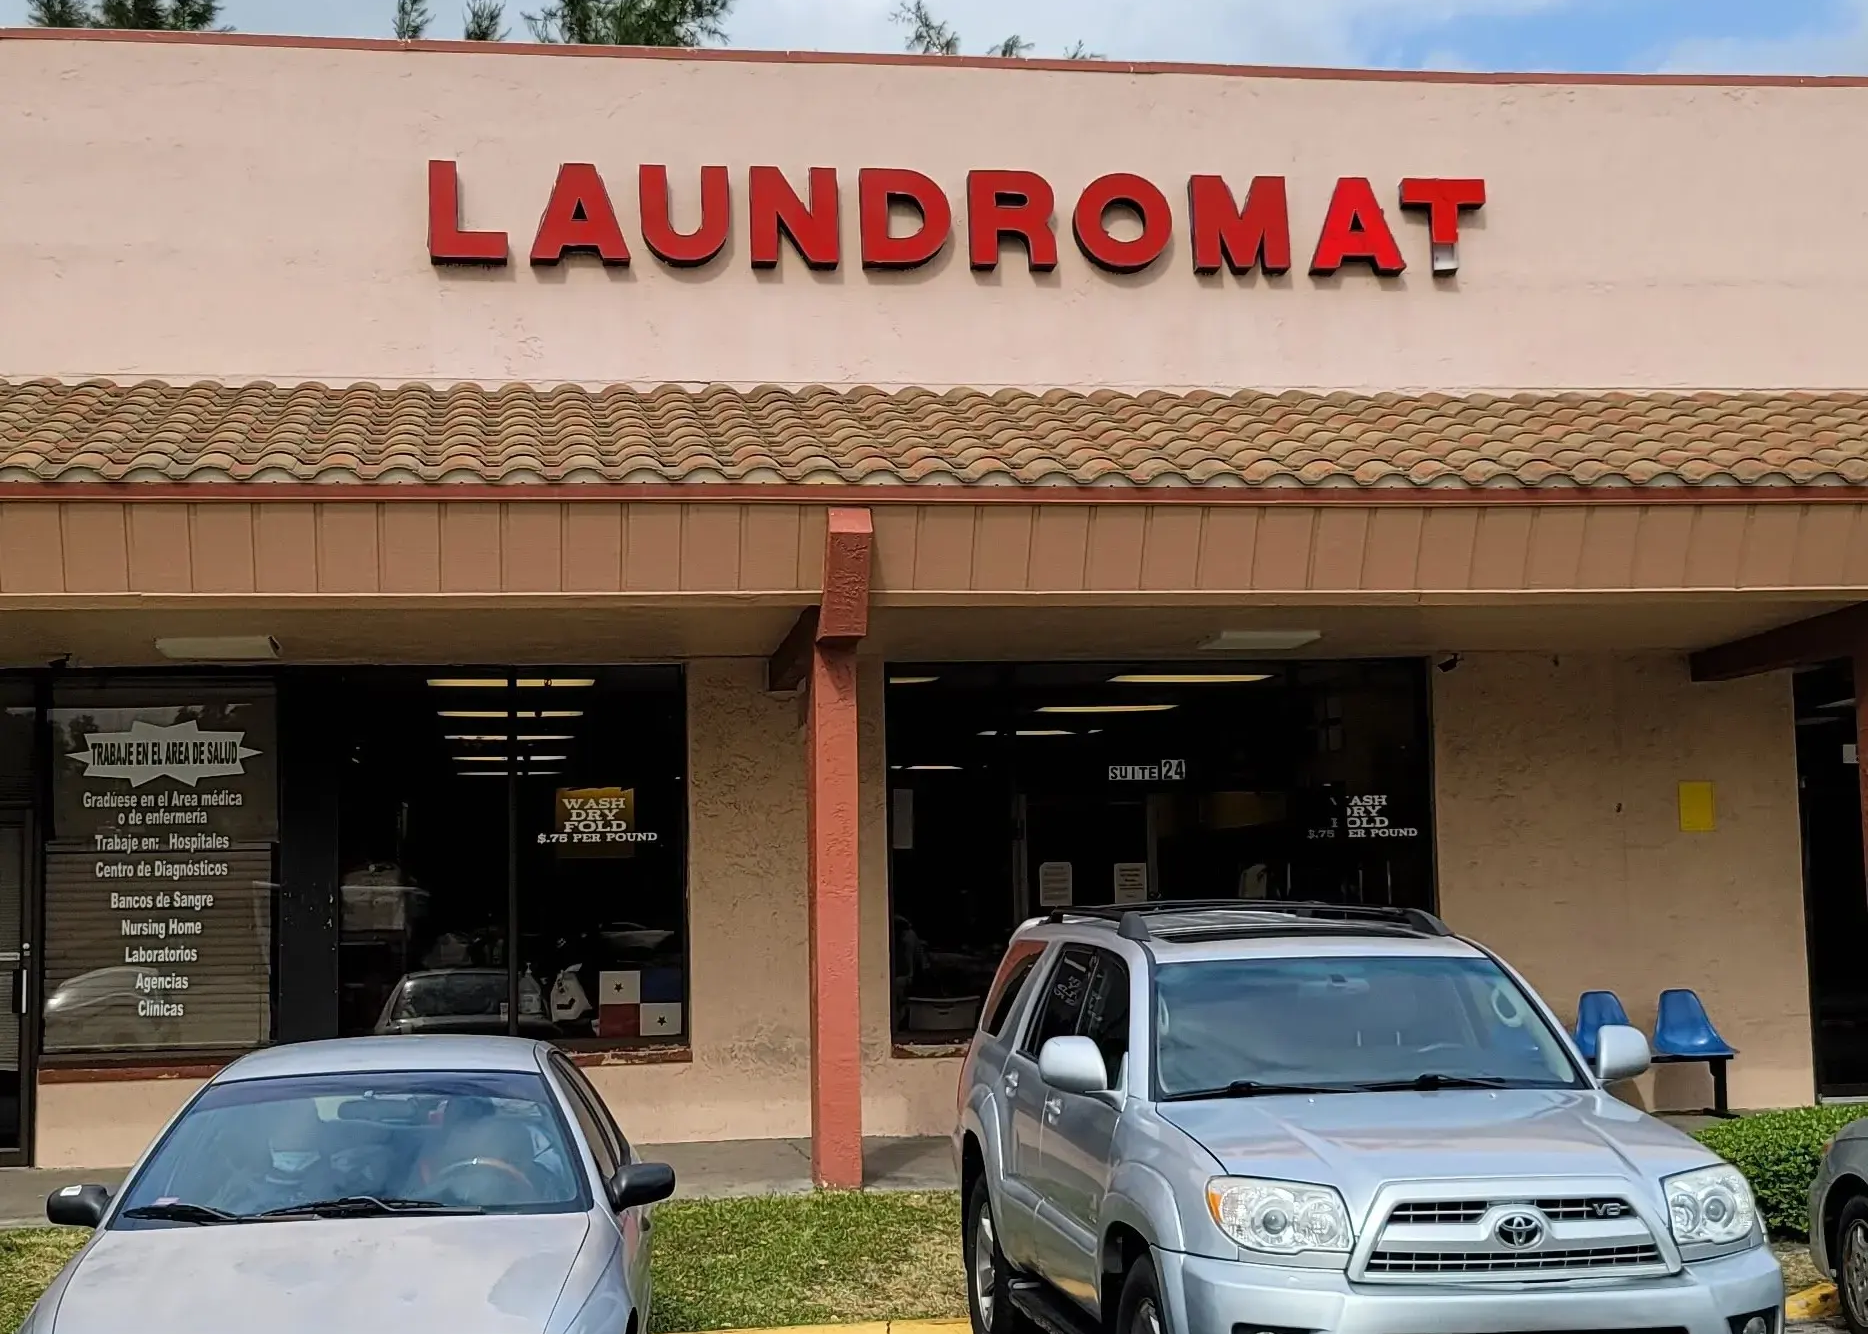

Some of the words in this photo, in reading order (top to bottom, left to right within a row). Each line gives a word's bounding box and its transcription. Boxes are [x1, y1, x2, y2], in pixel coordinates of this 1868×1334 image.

[428, 159, 1486, 277] LAUNDROMAT
[91, 742, 133, 765] TRABAJE
[135, 742, 149, 765] EN
[151, 741, 163, 765] EL
[165, 741, 190, 765] AREA
[192, 741, 205, 765] DE
[207, 741, 238, 764] SALUD
[1110, 766, 1157, 780] SUITE
[1163, 760, 1185, 780] 24
[140, 794, 155, 807] en
[157, 791, 169, 807] el
[171, 791, 198, 807] Area
[201, 790, 243, 806] médica
[562, 798, 626, 809] WASH
[118, 812, 126, 825] o
[128, 809, 142, 825] de
[145, 808, 208, 825] enfermería
[570, 809, 620, 820] DRY
[563, 821, 627, 832] FOLD
[1347, 829, 1367, 838] ER
[1370, 828, 1418, 838] POUND
[95, 834, 138, 854] Trabaje
[141, 837, 160, 850] en:
[169, 833, 230, 853] Hospitales
[537, 833, 568, 844] $.75
[572, 833, 602, 843] PER
[606, 832, 658, 842] POUND
[95, 861, 134, 878] Centro
[137, 861, 151, 877] de
[111, 892, 153, 909] Bancos
[156, 892, 170, 908] de
[173, 891, 214, 910] Sangre
[121, 919, 166, 939] Nursing
[168, 918, 202, 935] Home
[125, 946, 198, 963] Laboratorios
[135, 973, 189, 993] Agencias
